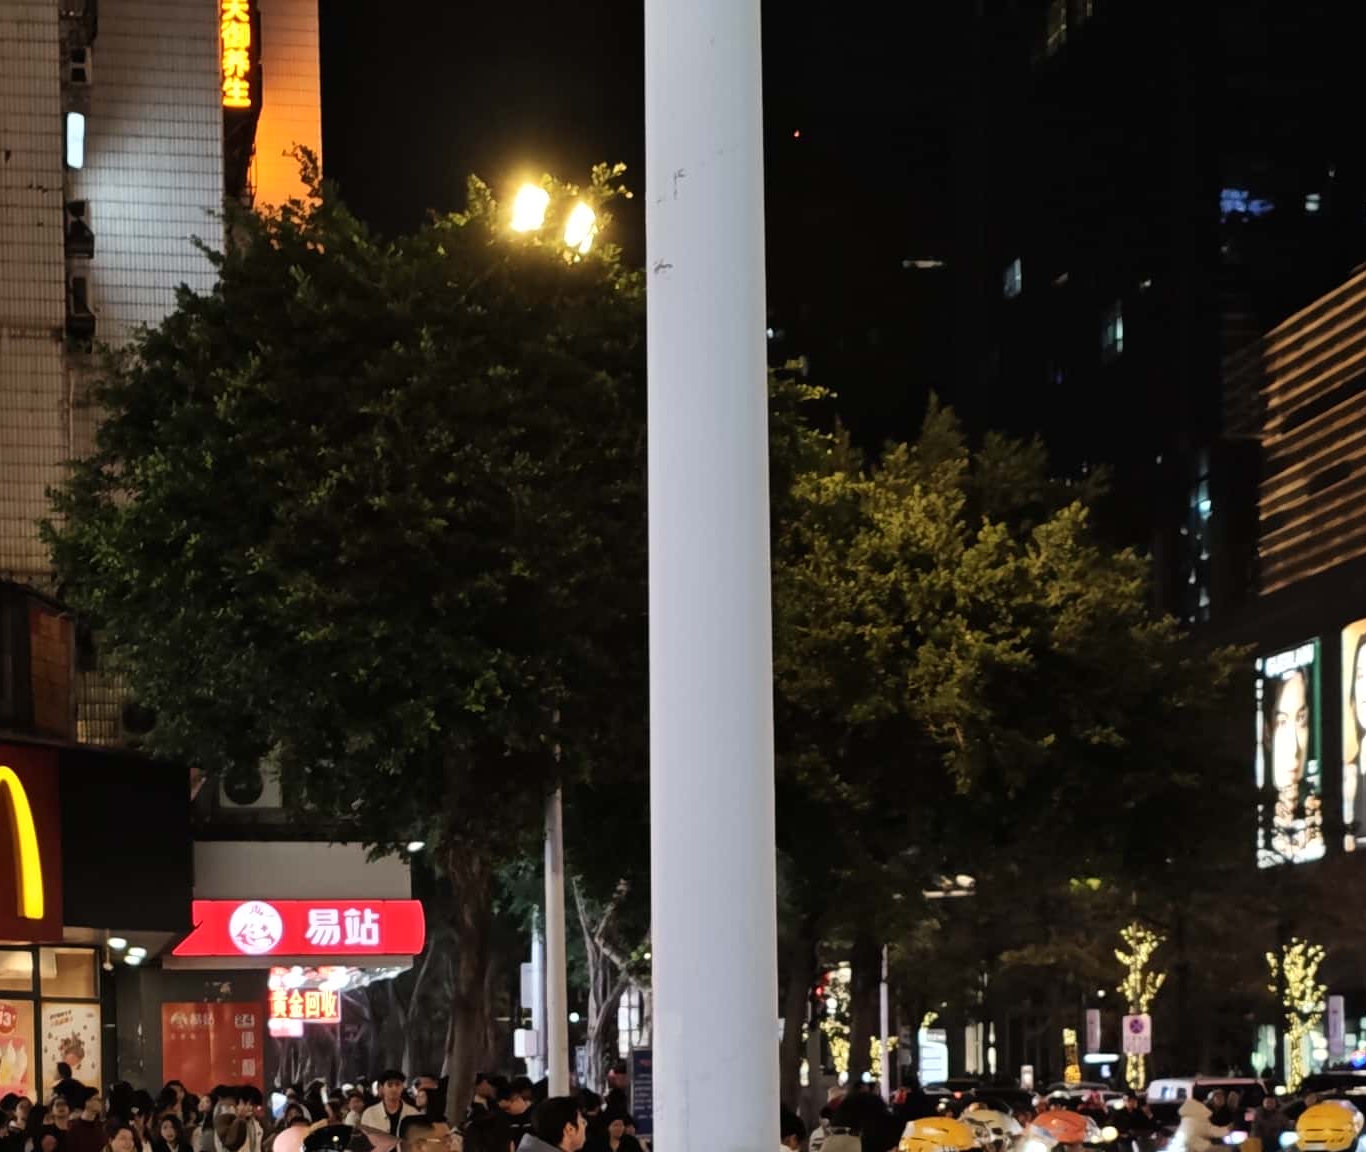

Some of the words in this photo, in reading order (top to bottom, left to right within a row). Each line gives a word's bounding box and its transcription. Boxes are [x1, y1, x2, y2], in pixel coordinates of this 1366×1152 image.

[305, 908, 380, 946] 易站
[271, 989, 338, 1018] 黄金回收
